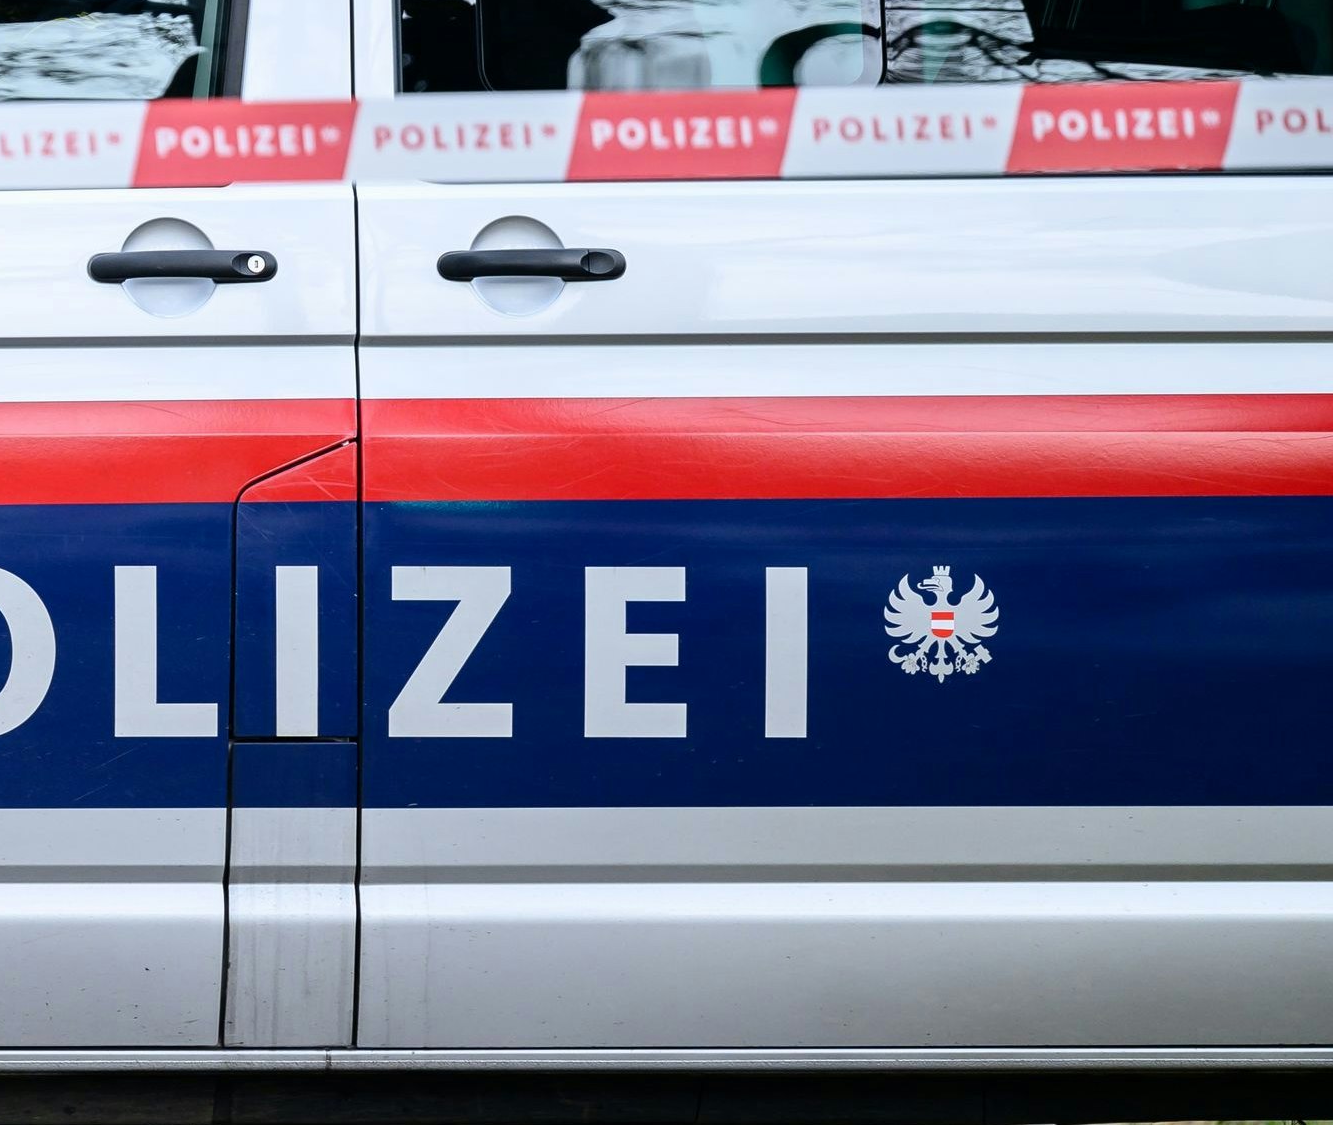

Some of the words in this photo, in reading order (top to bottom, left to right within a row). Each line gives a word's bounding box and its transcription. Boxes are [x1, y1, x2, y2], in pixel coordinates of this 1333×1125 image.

[155, 125, 316, 158] POLIZEI
[374, 122, 531, 151] POLIZEI
[591, 117, 753, 151] POLIZEI
[813, 115, 973, 144] POLIZEI
[1032, 108, 1196, 142] POLIZEI
